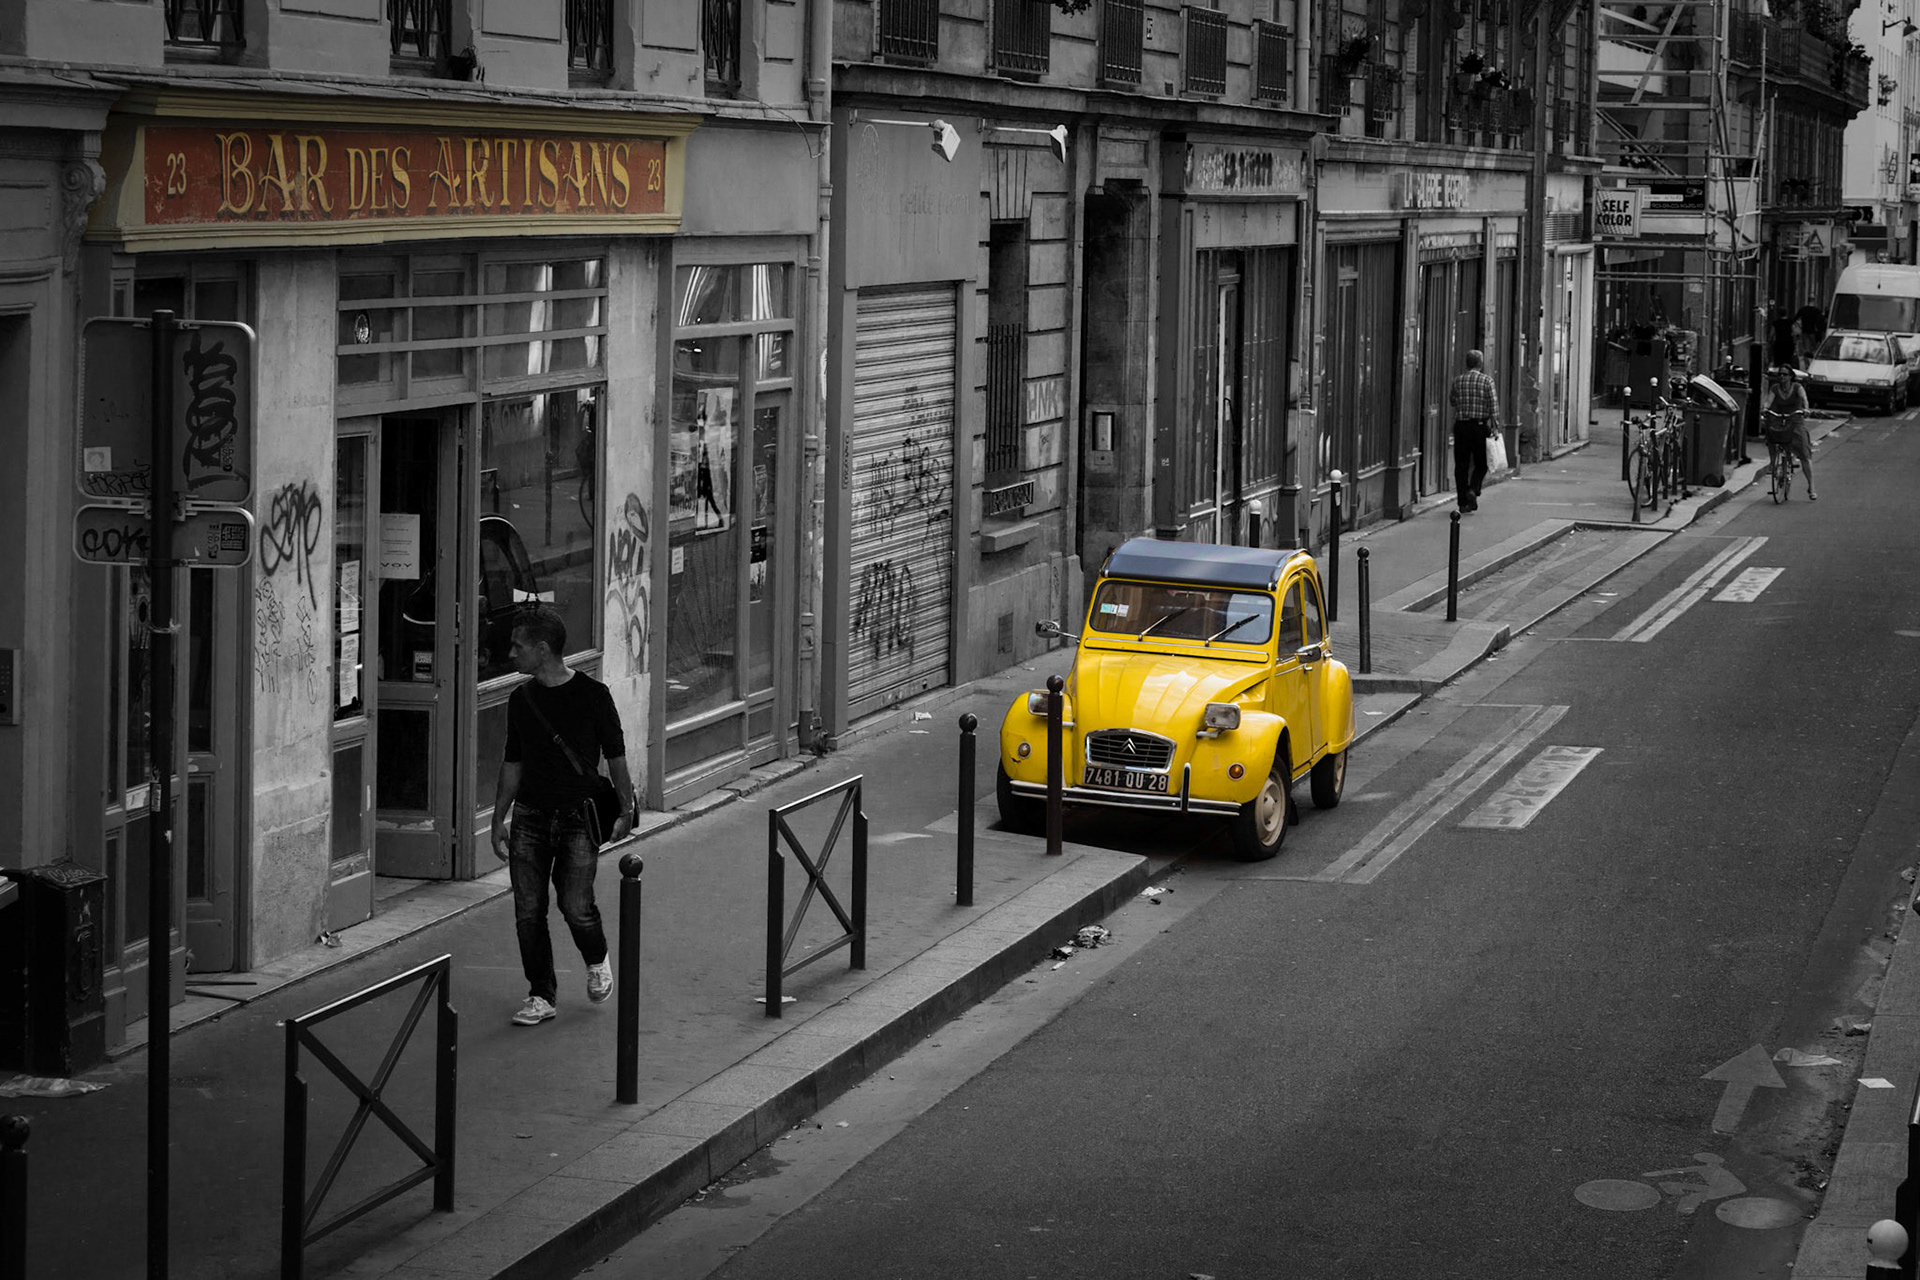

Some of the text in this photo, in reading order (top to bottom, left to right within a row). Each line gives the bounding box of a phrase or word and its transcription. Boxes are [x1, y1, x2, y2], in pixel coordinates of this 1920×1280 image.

[166, 131, 661, 216] 23 BAR DES ARTISANS 23
[1602, 200, 1630, 213] SELF
[1597, 214, 1632, 226] COLOR
[1086, 767, 1120, 787] 7481
[1148, 774, 1168, 791] 28
